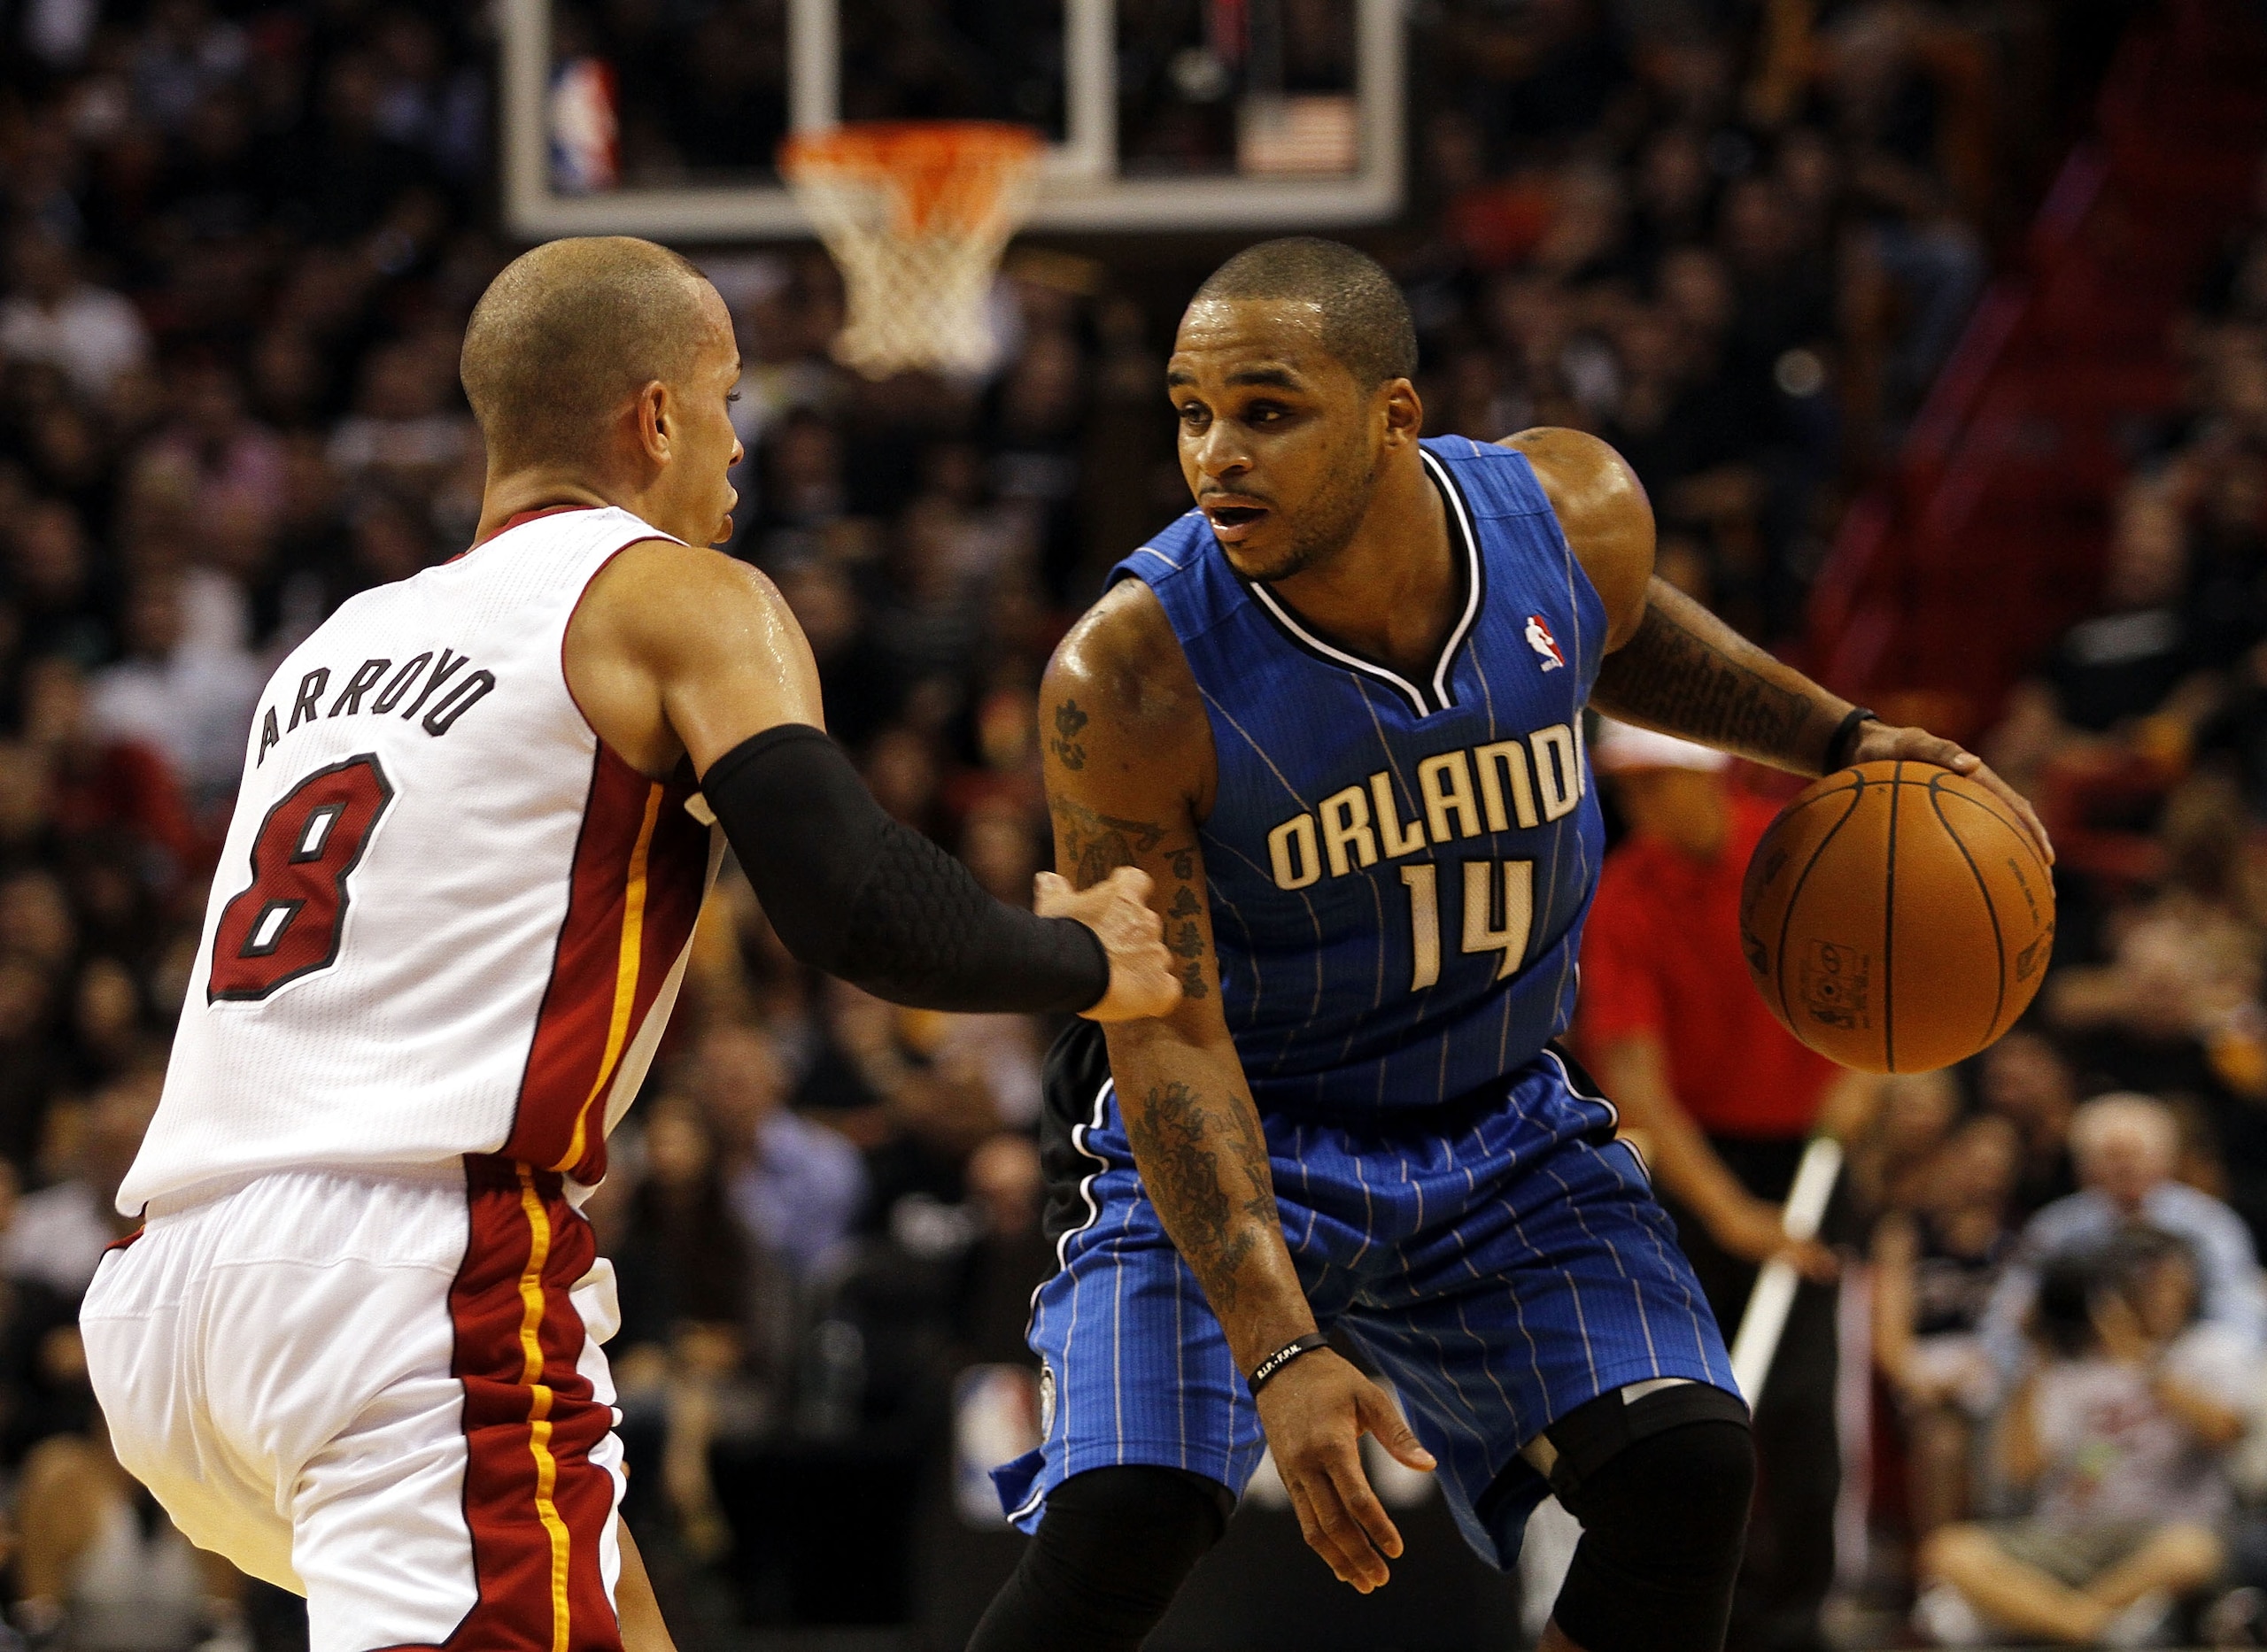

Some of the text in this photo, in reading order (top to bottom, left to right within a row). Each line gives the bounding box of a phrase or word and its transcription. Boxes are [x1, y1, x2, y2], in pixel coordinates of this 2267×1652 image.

[258, 648, 495, 768] ARROYO
[1268, 709, 1585, 891] ORLAND
[207, 752, 395, 1007] 8
[1400, 861, 1533, 992] 14
